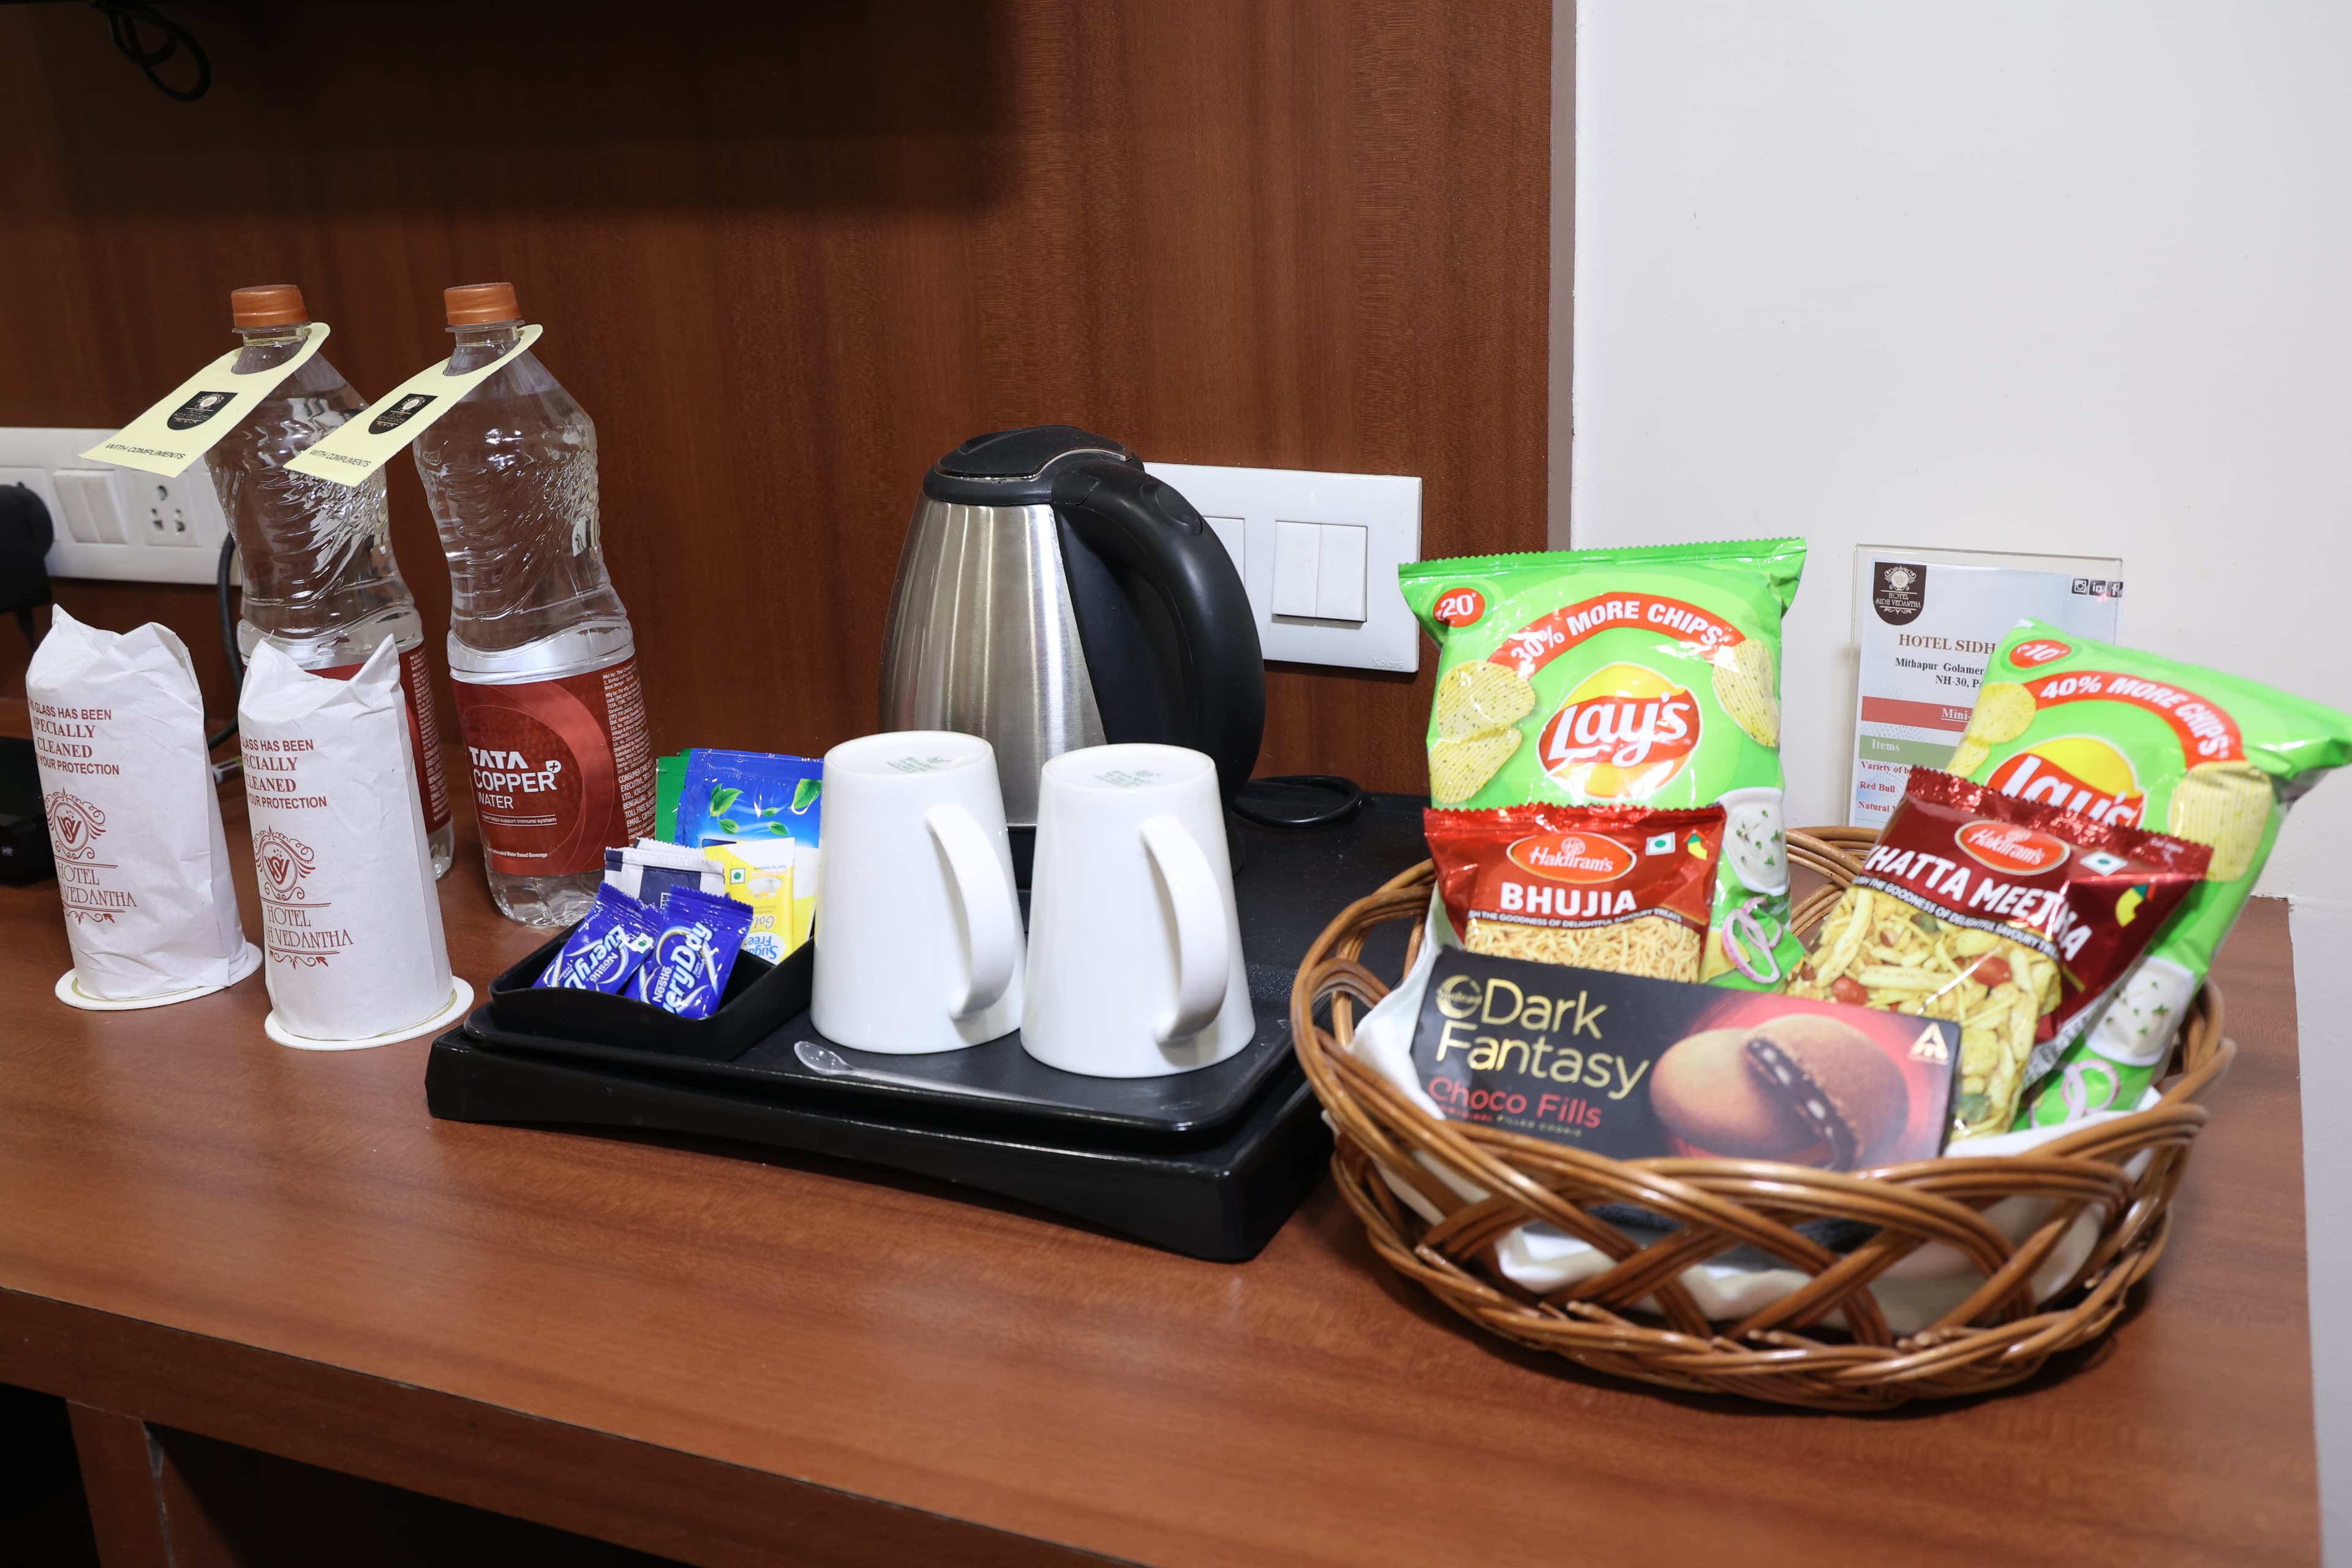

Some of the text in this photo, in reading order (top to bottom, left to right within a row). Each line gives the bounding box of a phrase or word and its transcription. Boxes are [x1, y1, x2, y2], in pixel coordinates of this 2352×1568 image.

[127, 447, 186, 460] COMPLIMENTS
[309, 450, 371, 468] WITH COMPLIMENTS
[1891, 600, 1921, 608] VEDANTHA
[1510, 625, 1565, 677] 30%
[1566, 600, 1640, 636] MORE
[1899, 634, 1997, 655] HOTEL SIDH
[1894, 657, 1985, 676] Mithapur Golamer
[1936, 675, 1970, 688] NH-30,
[2040, 675, 2103, 699] 40%
[2106, 677, 2189, 709] MORE
[35, 701, 56, 717] GLASS
[58, 707, 78, 720] HAS
[81, 709, 111, 721] BEEN
[33, 715, 96, 738] SPECIALLY
[1547, 691, 1691, 768] Lay's
[37, 737, 93, 758] CLEANED
[260, 739, 280, 752] HAS
[282, 739, 314, 752] BEEN
[1871, 739, 1900, 752] Items
[39, 755, 56, 770] YOUR
[58, 761, 119, 775] PROTECTION
[468, 746, 529, 770] TATA
[1861, 761, 1891, 774] Variety
[246, 773, 296, 793] CLEANED
[473, 768, 558, 793] COPPER
[1860, 782, 1895, 793] Red Bull
[262, 796, 327, 809] PROTECTION
[477, 791, 514, 809] WATER
[1858, 801, 1890, 812] Natural
[625, 809, 637, 818] TOLL
[1967, 827, 2045, 865] Haldiram's
[1529, 846, 1614, 873] Haldiram's
[58, 862, 100, 886] HOTEL
[1864, 845, 1971, 902] HATTA
[62, 884, 137, 907] VEDANTHA
[1499, 882, 1637, 917] BHUJIA
[1884, 883, 1937, 914] GOODNESS
[1934, 906, 1952, 919] OF
[267, 905, 312, 927] HOTEL
[754, 916, 775, 929] Gol
[1499, 913, 1548, 927] GOODNESS
[1548, 919, 1562, 927] OF
[274, 929, 354, 948] VEDANTHA
[748, 935, 772, 946] Free
[1481, 978, 1608, 1040] Dark
[1435, 1019, 1650, 1100] Fantasy
[1428, 1076, 1602, 1128] Choco Fills
